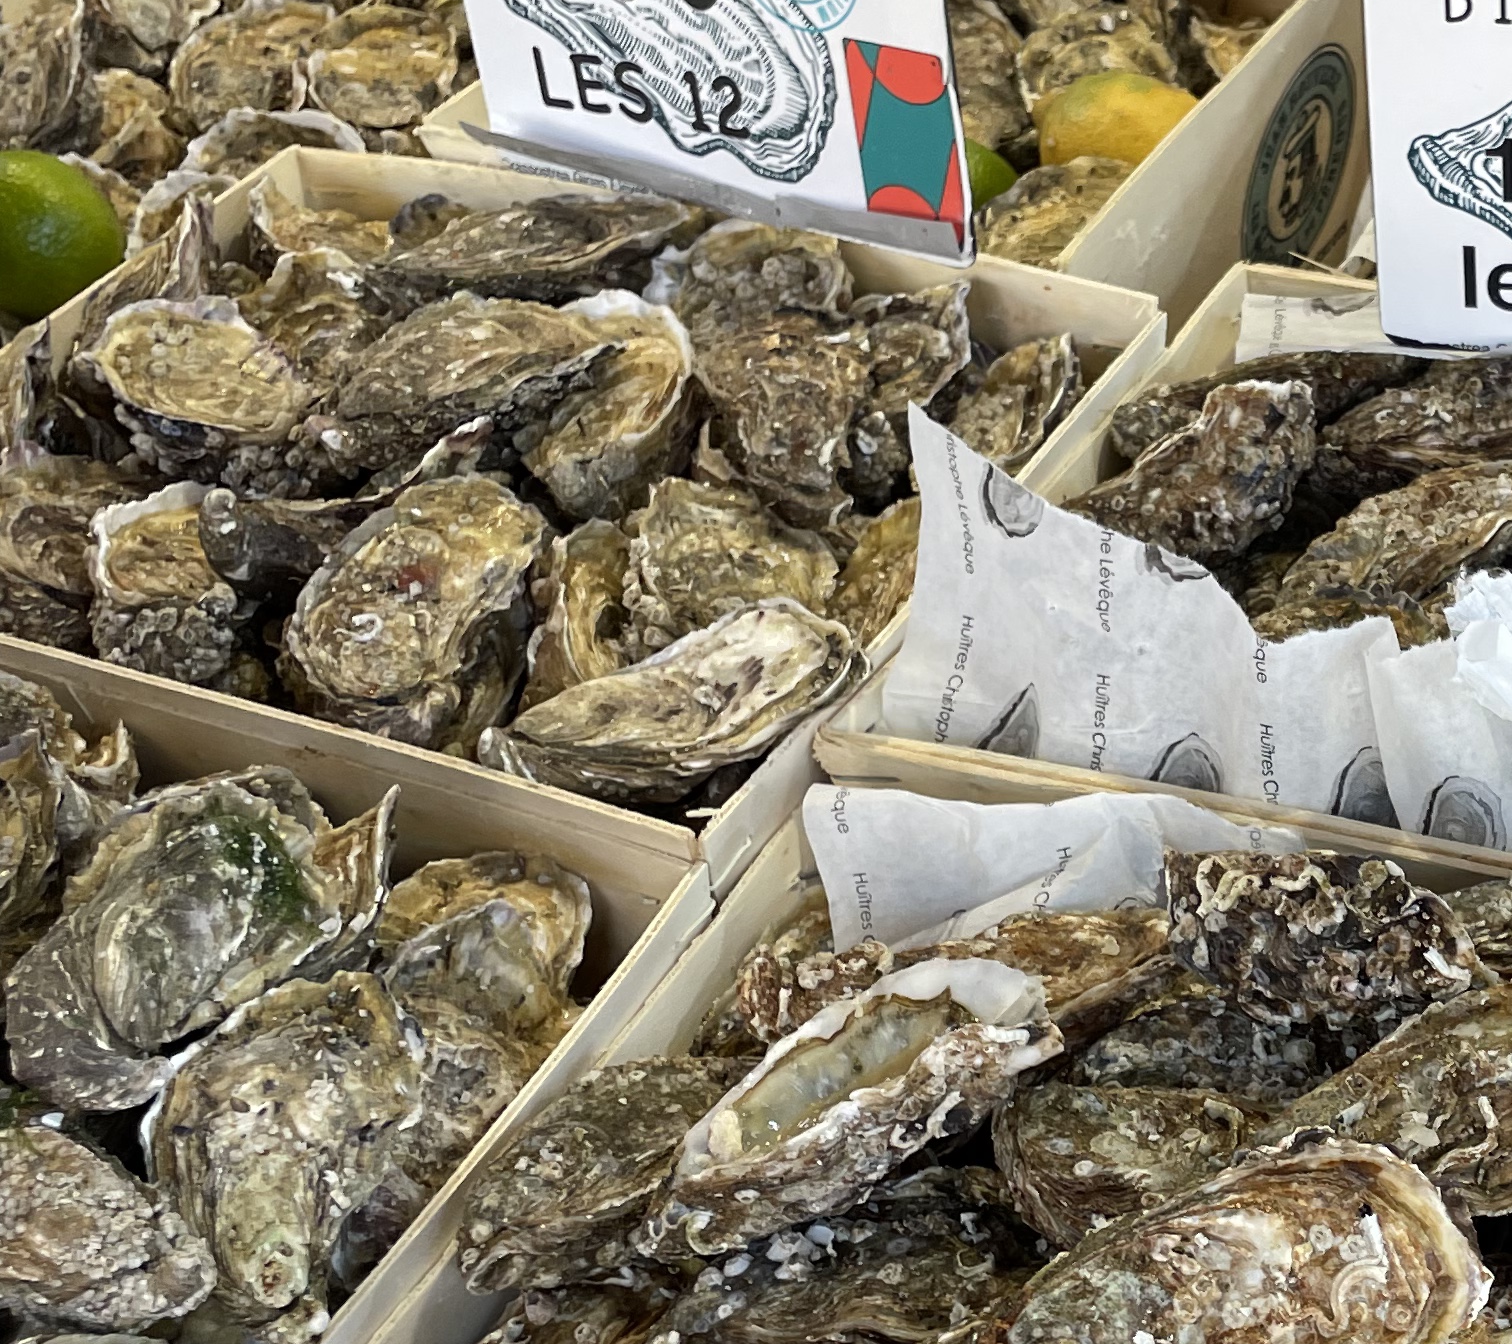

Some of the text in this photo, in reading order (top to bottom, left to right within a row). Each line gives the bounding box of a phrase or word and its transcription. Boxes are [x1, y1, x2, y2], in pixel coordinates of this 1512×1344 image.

[533, 46, 752, 140] LES 12
[1093, 672, 1112, 728] Huîtres
[1258, 722, 1276, 777] Huîtres
[852, 871, 876, 931] Huîtres
